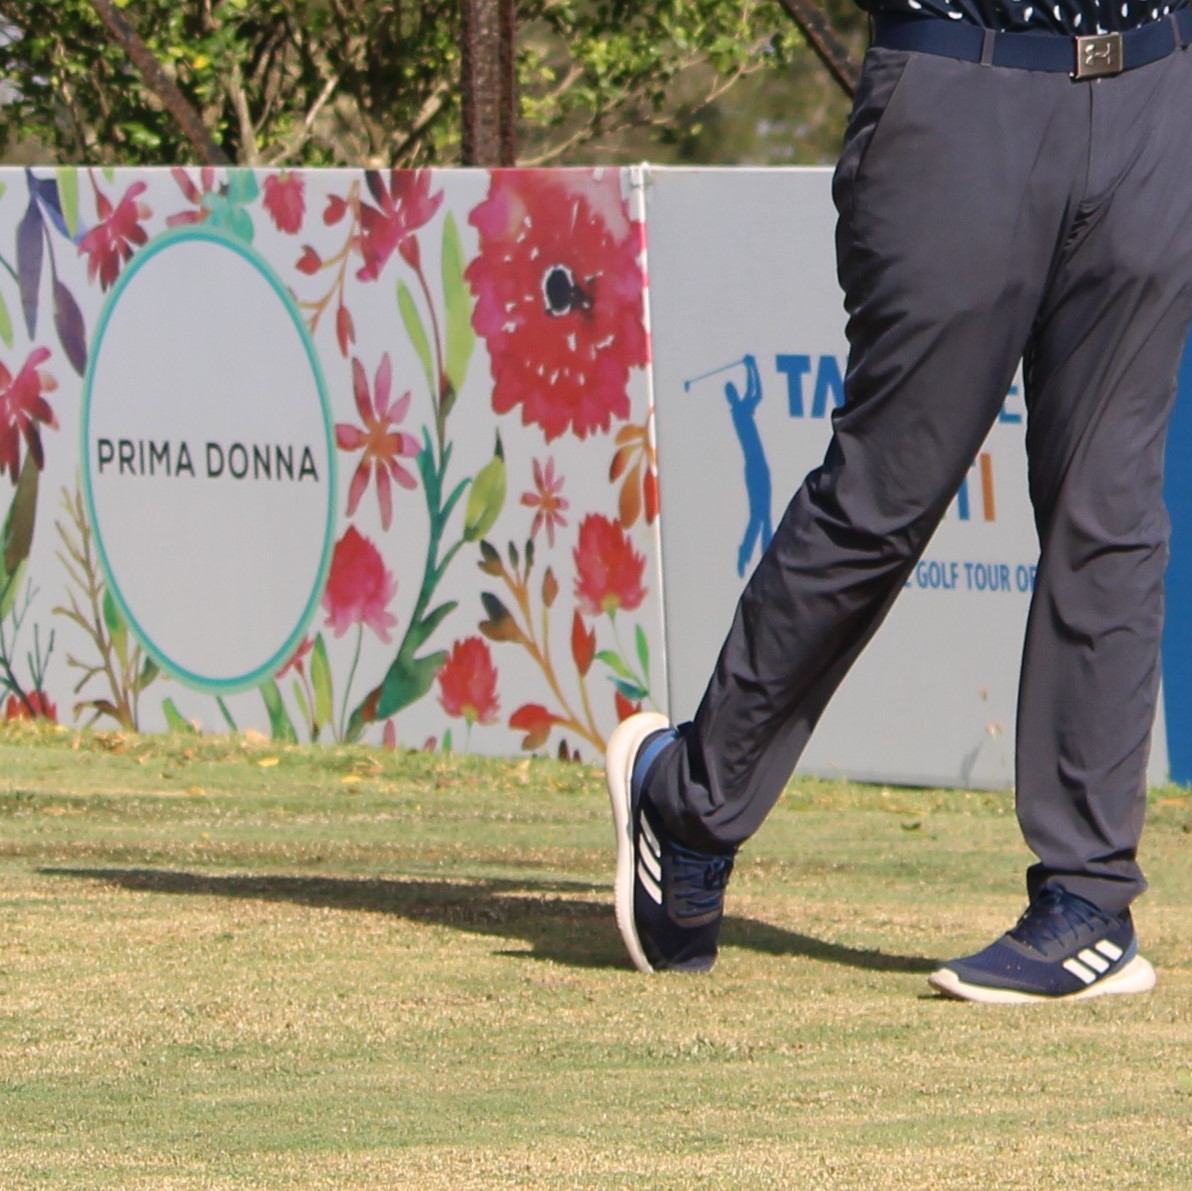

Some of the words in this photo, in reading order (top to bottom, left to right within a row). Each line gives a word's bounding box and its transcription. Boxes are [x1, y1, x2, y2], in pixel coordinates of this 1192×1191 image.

[97, 438, 195, 477] PRIMA
[205, 442, 319, 482] DONNA
[916, 561, 958, 589] GOLF
[964, 562, 1011, 592] TOUR
